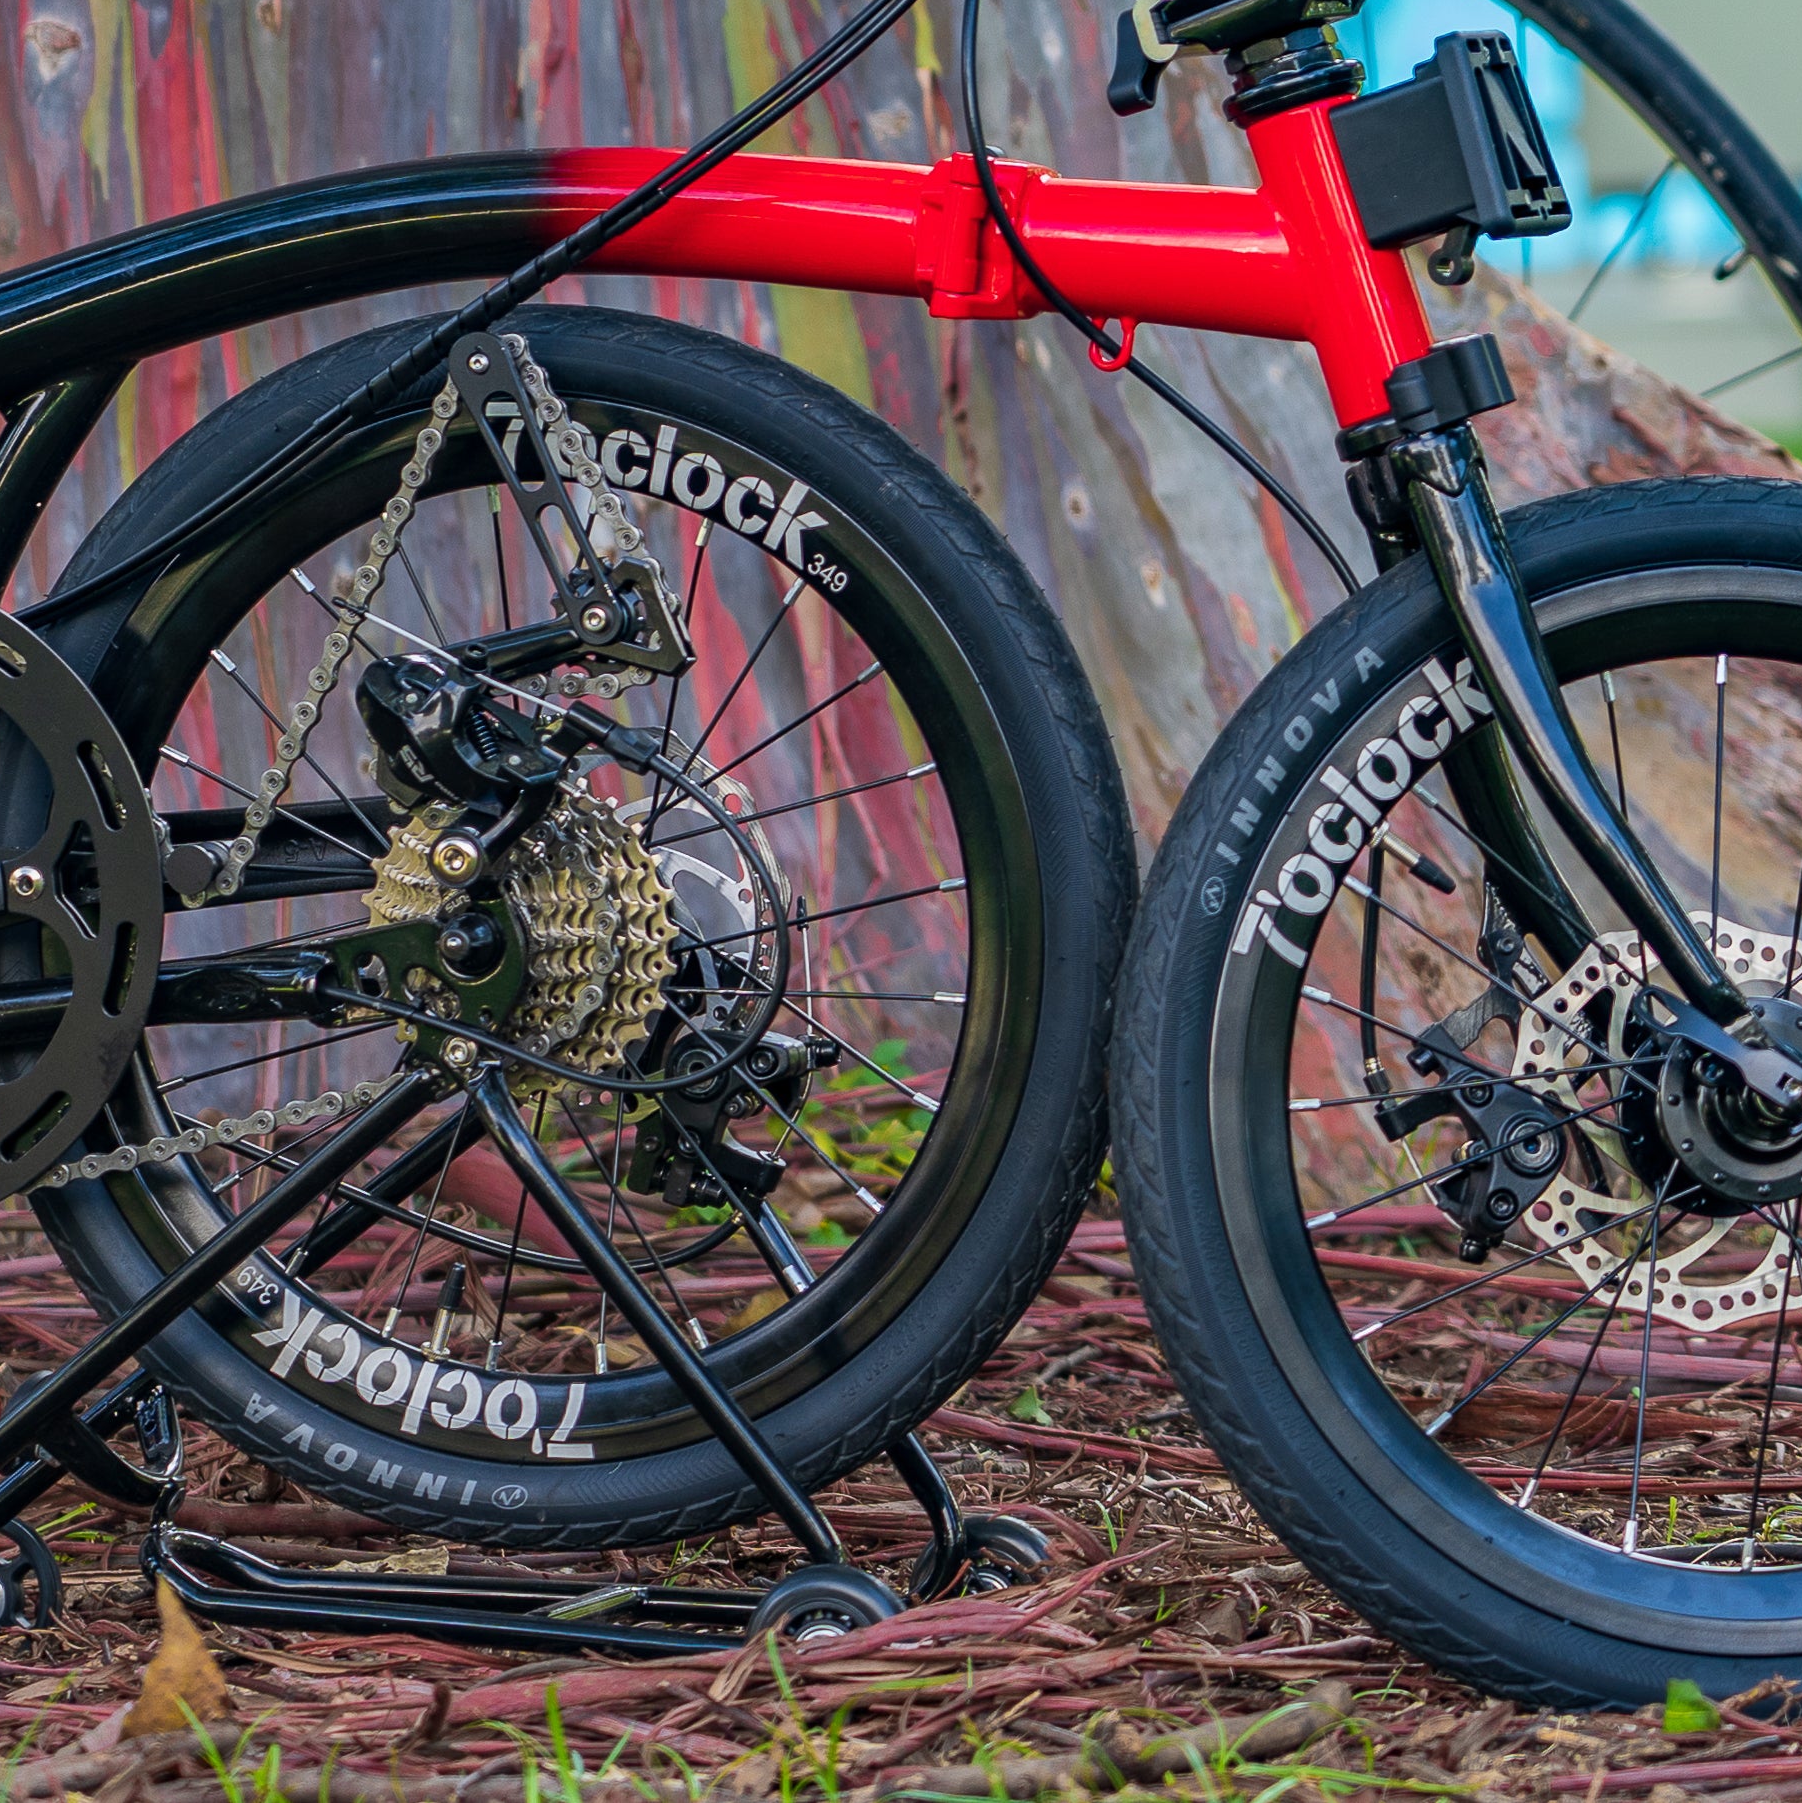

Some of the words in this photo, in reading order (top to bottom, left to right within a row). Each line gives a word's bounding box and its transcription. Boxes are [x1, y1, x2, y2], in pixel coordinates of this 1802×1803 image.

[808, 554, 847, 592] 349
[1215, 646, 1385, 866] INNOVA
[1232, 655, 1495, 968] 7'oclock
[237, 1265, 279, 1306] 349
[251, 1288, 595, 1459] 7'oclock
[244, 1392, 478, 1506] INNOVA
